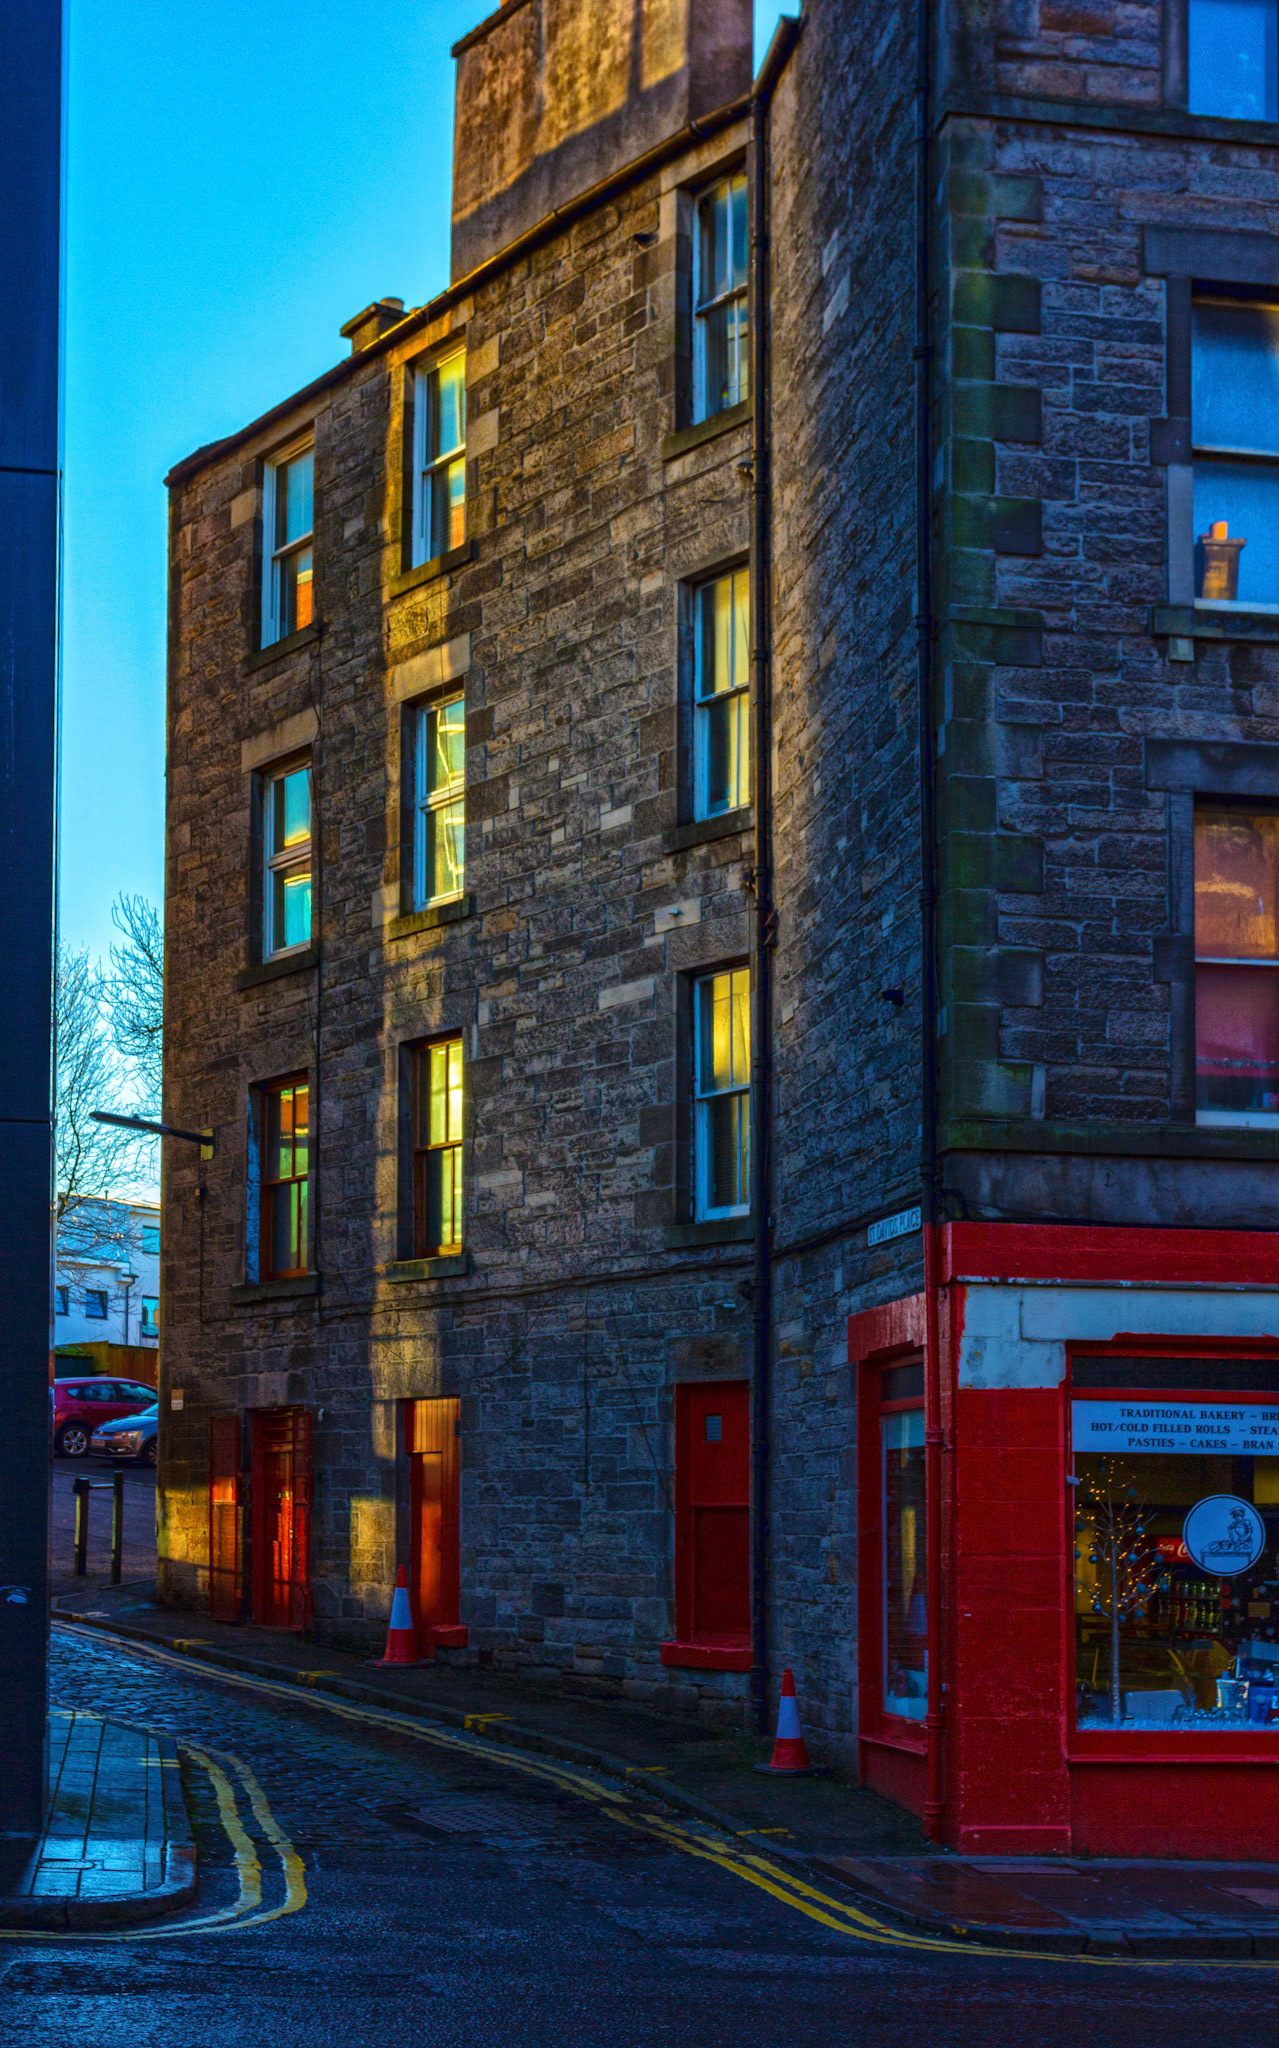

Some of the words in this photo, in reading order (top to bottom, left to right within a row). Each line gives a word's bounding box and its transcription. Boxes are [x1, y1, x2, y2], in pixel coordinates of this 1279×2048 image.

[899, 1210, 919, 1233] PLACE
[1119, 1408, 1196, 1420] TRADITIONAL
[1200, 1410, 1246, 1421] BAKERY
[1090, 1422, 1149, 1433] HOT/COLD
[1152, 1423, 1192, 1434] FILLED
[1195, 1425, 1231, 1435] ROLLS
[1250, 1426, 1279, 1436] STEA
[1127, 1437, 1175, 1448] PASTIES
[1190, 1439, 1227, 1449] CAKES
[1243, 1440, 1274, 1450] BRAN
